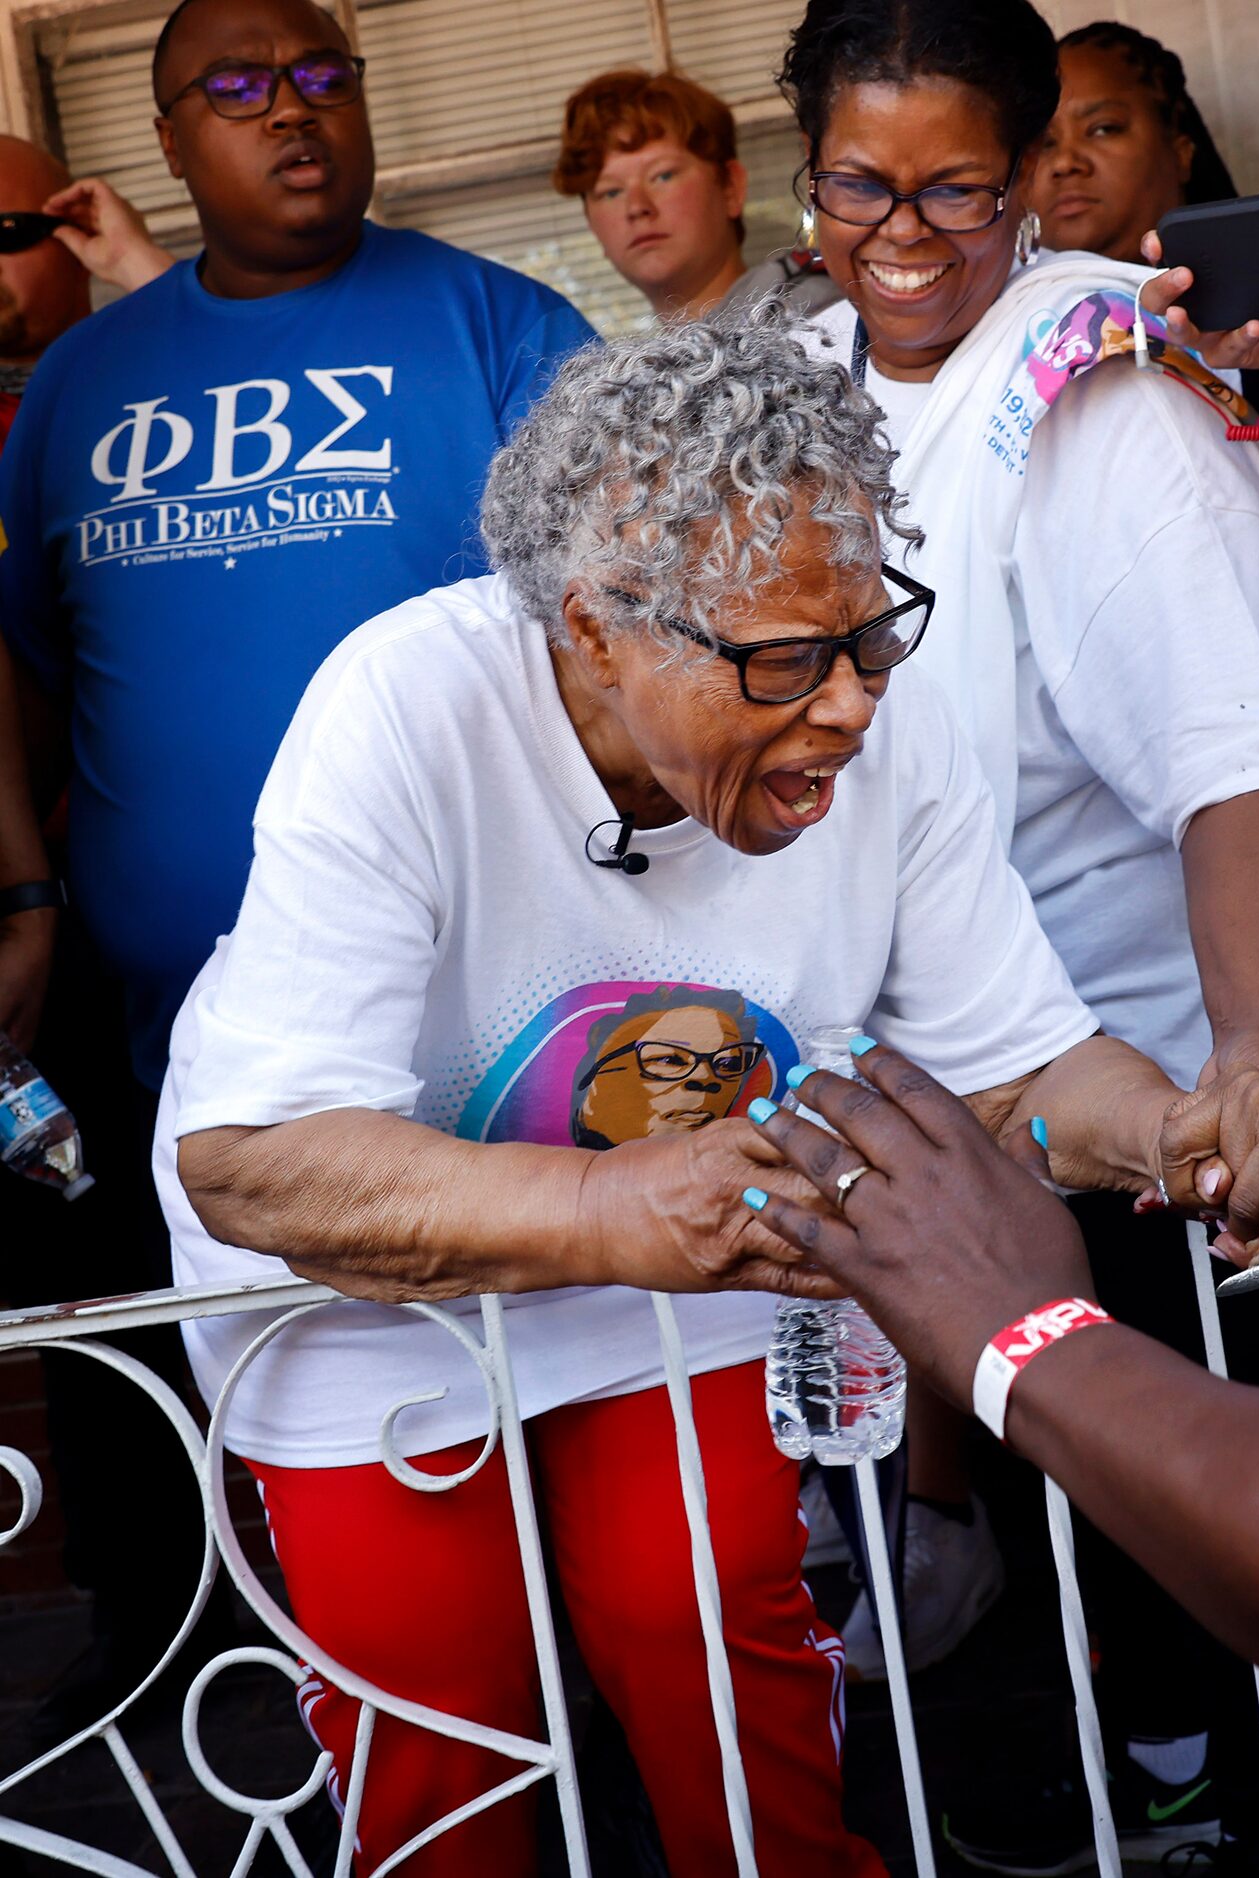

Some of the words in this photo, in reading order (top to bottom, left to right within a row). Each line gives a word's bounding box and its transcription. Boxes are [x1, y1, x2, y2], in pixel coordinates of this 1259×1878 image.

[75, 516, 147, 563] PHI
[151, 502, 262, 545] BETA
[266, 485, 399, 529] SIGMA
[169, 549, 185, 561] for
[261, 536, 277, 548] for
